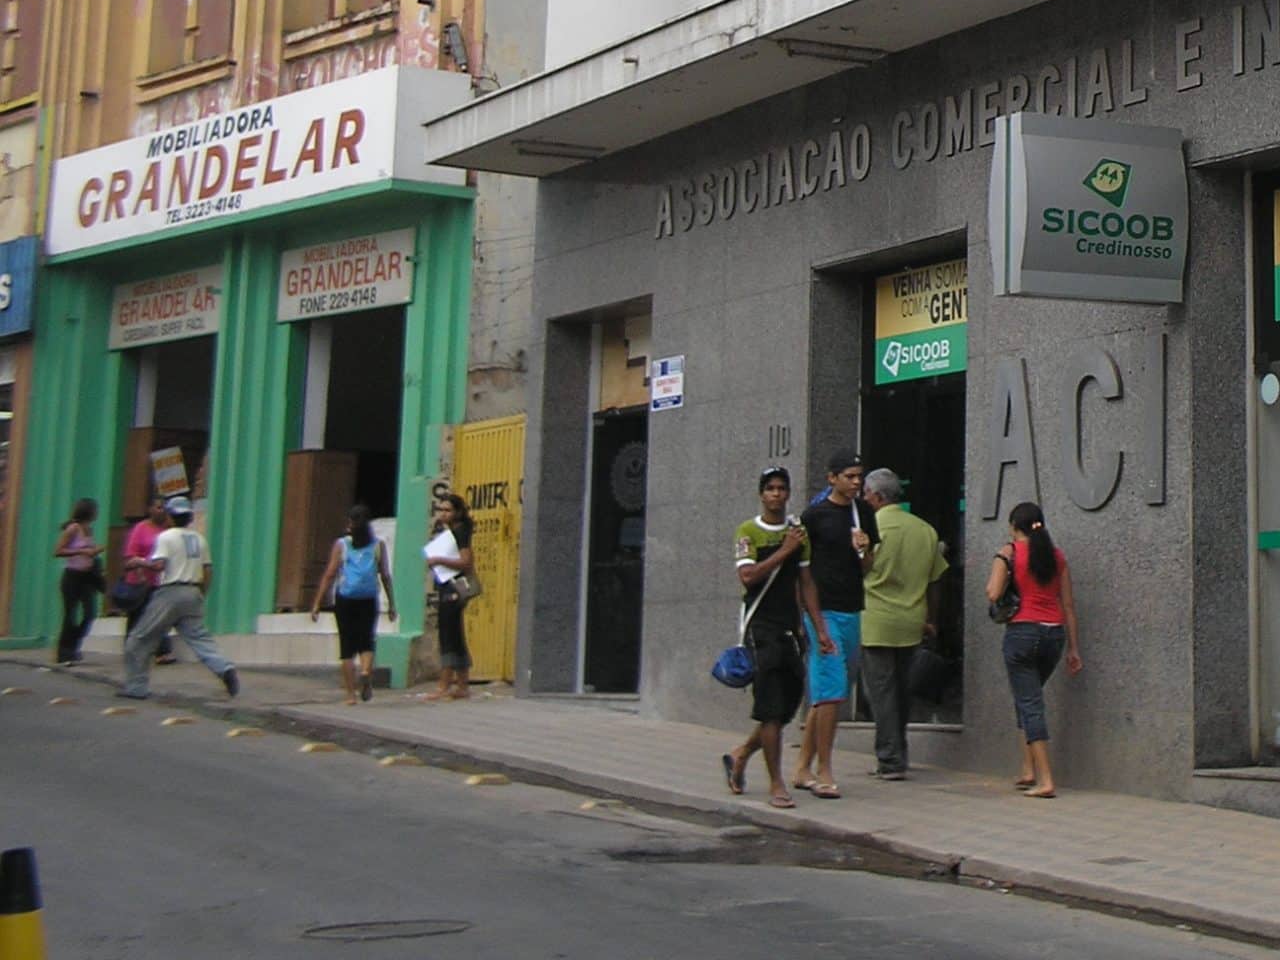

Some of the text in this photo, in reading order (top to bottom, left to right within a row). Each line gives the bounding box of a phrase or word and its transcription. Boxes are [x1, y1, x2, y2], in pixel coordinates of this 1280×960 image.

[147, 105, 274, 159] MOBILIADORA
[655, 116, 873, 239] ASSOCIAÇÃO
[892, 40, 1148, 171] COMERCIAL
[1175, 19, 1203, 93] E
[77, 108, 366, 228] GRANDELAR
[1042, 207, 1174, 240] SICOOB
[303, 238, 379, 264] MOBILIADORA
[1076, 238, 1172, 259] Credinosso
[287, 250, 402, 297] GRANDELAR
[893, 269, 932, 298] VENHA
[119, 286, 215, 326] GRANDELAR
[300, 294, 328, 315] FONE
[901, 340, 950, 364] SICOOB
[980, 333, 1168, 524] ACI
